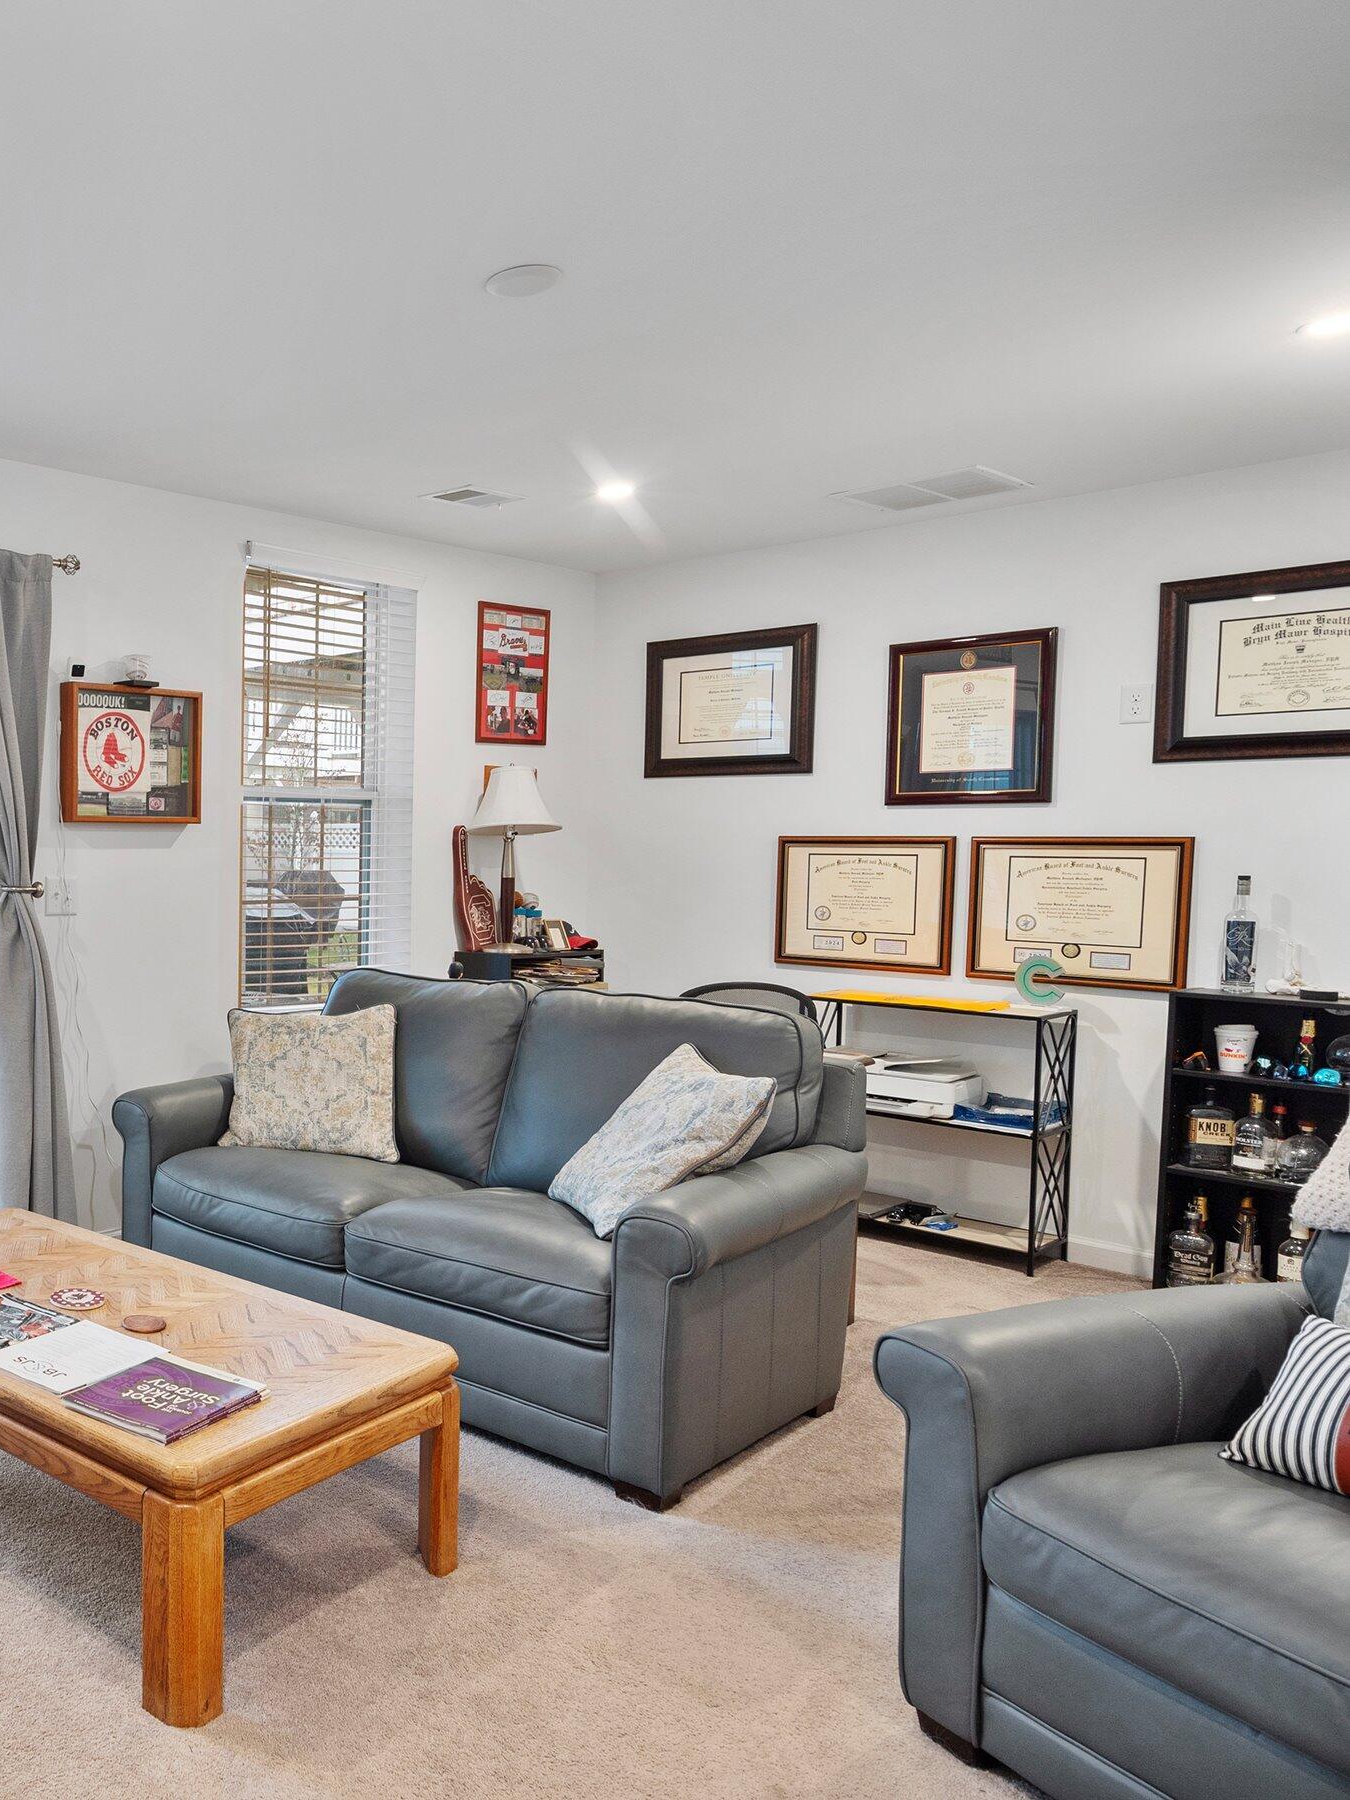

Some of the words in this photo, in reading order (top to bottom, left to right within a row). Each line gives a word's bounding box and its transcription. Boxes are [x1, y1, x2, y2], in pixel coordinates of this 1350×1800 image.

[1251, 622, 1281, 634] Main
[1285, 617, 1311, 627] Line
[1243, 636, 1271, 647] Bryn
[1274, 629, 1309, 640] Mawr
[89, 717, 138, 741] BOSTON
[91, 764, 113, 786] RED
[118, 766, 138, 786] SOX
[1016, 866, 1042, 878] American
[1096, 862, 1114, 871] Ankle
[1198, 1121, 1226, 1133] KNOB
[121, 1389, 166, 1410] Foot
[136, 1383, 186, 1405] Ankle
[142, 1378, 220, 1405] Surgery
